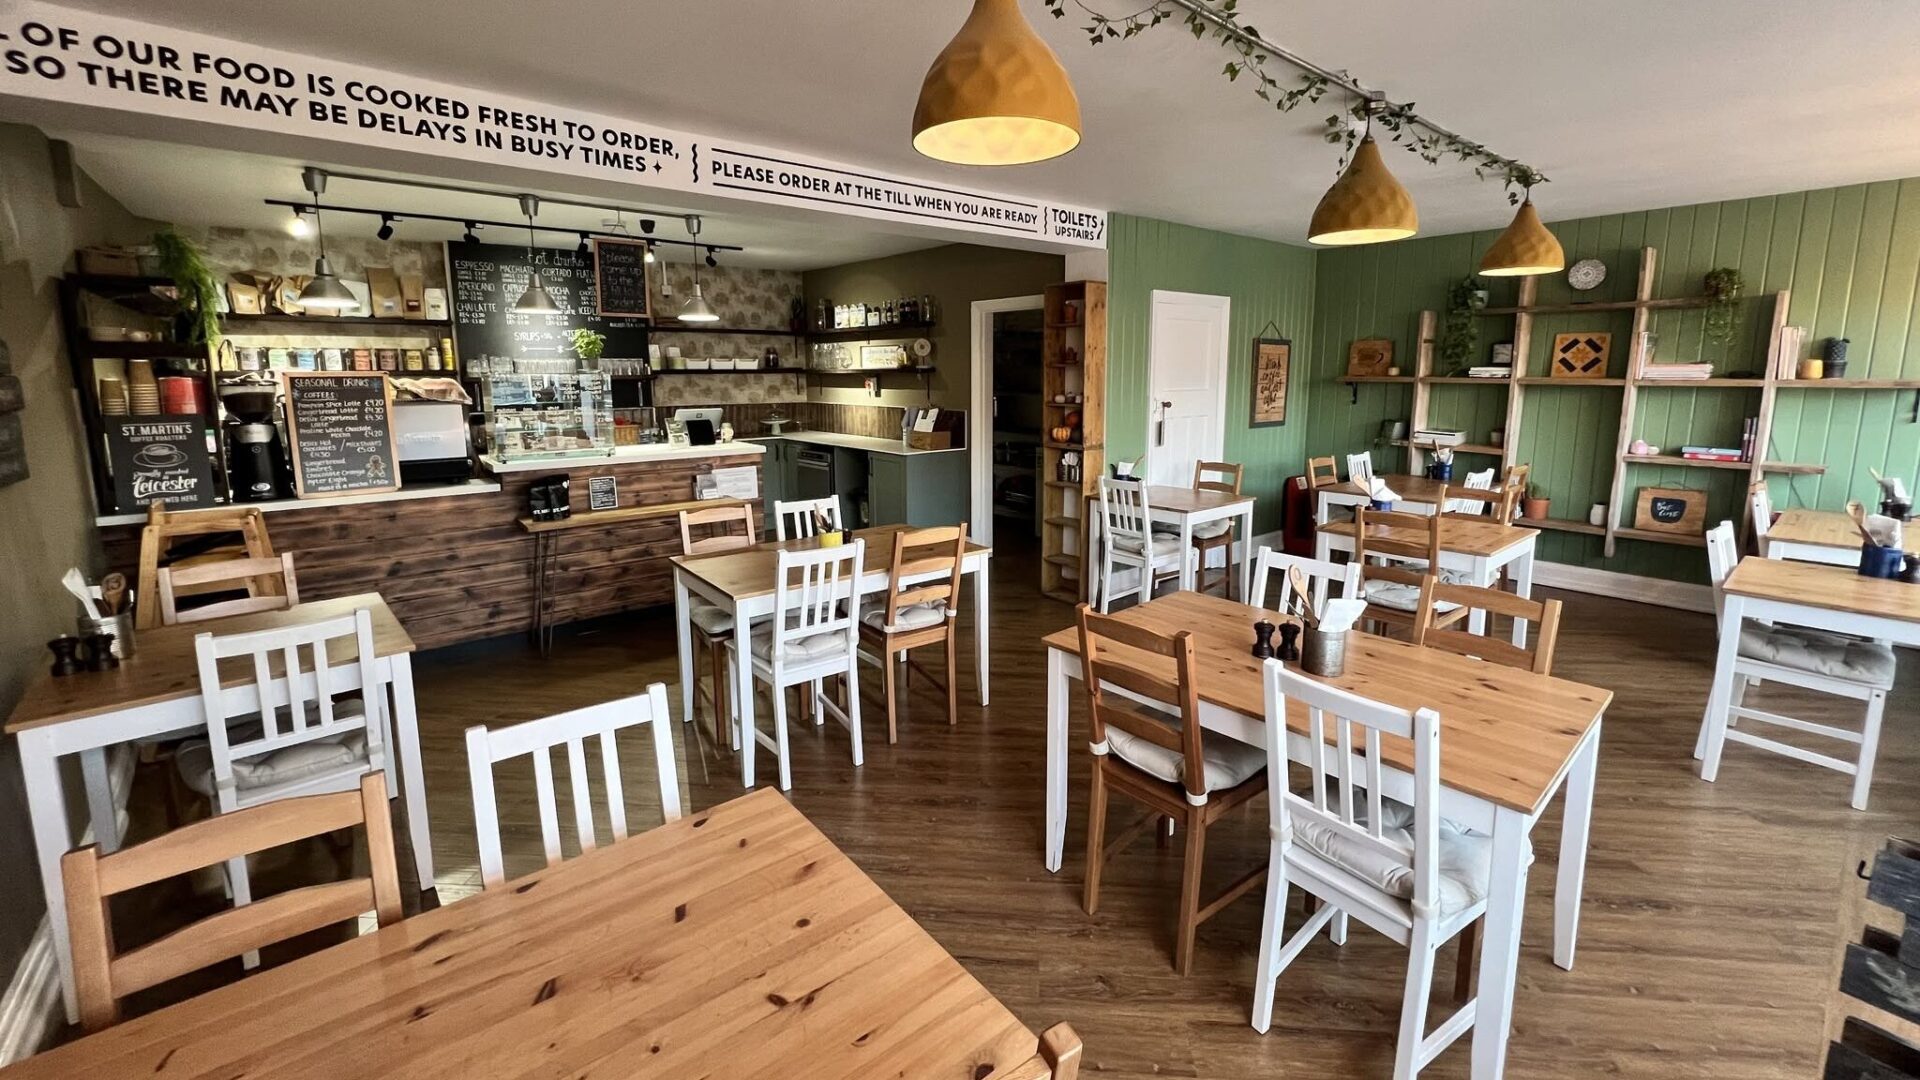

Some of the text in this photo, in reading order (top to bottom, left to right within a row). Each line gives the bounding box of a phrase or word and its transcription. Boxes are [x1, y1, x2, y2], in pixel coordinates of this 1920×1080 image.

[21, 22, 679, 160] OF OUR FOOD IS COOKED FRESH TO ORDER,
[4, 50, 646, 173] SO THERE MAY BE DELAYS IN BUSY TIMES
[712, 160, 1038, 225] PLEASE ORDER AT THE TILL WHEN YOU ARE READY
[1051, 208, 1098, 229] TOILETS
[1055, 226, 1095, 241] UPSTAIRS
[455, 260, 495, 272] ESPRESSO
[500, 265, 534, 275] MACCHIATO
[541, 267, 572, 278] CORTADO
[458, 281, 495, 292] AMERICANO
[545, 286, 570, 295] MOCHA
[514, 331, 540, 341] SYRUPS
[295, 378, 370, 388] SEASONAL DRINKS
[131, 476, 198, 498] Leicester
